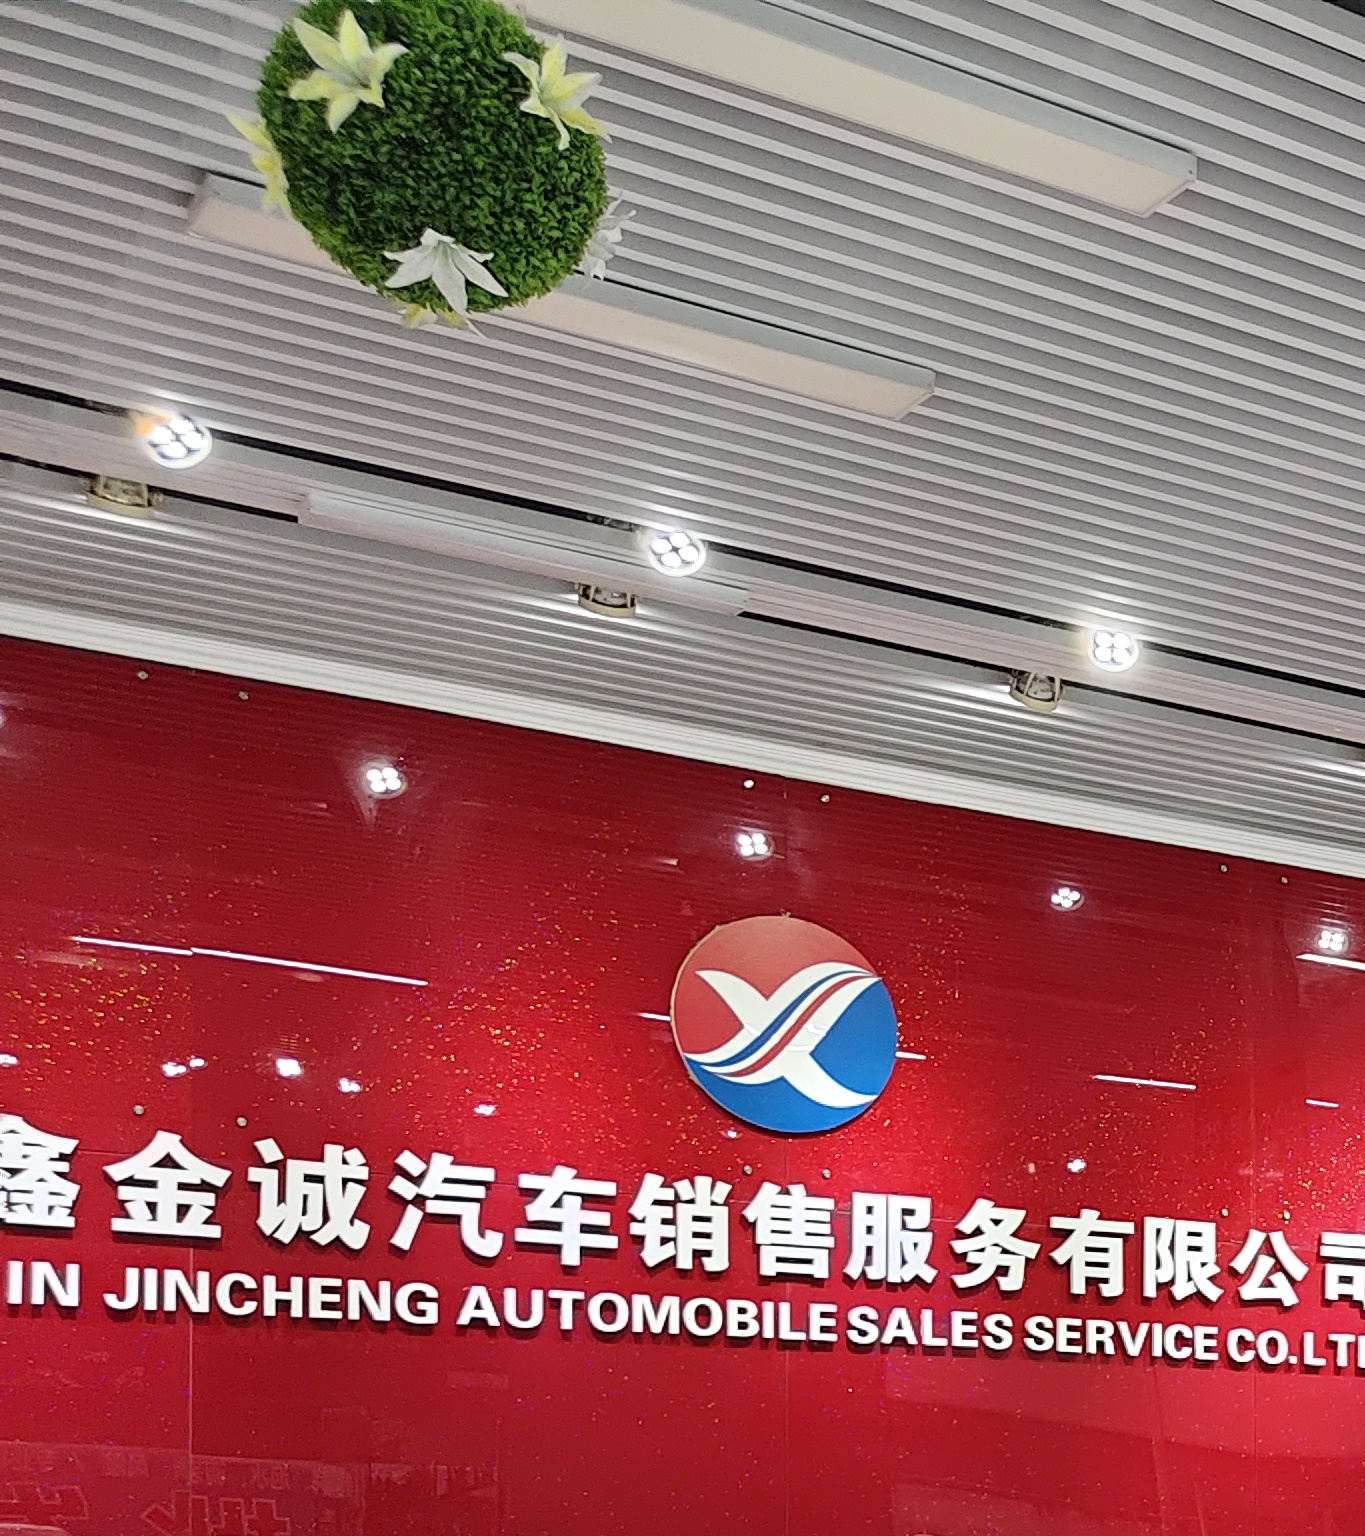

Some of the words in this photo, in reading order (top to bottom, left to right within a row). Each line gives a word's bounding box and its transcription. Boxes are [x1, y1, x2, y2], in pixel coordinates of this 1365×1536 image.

[103, 1267, 439, 1326] JINCHENG
[456, 1285, 838, 1342] AUTOMOBILE
[846, 1305, 1013, 1350] SALES
[1023, 1315, 1219, 1362] SERVICE
